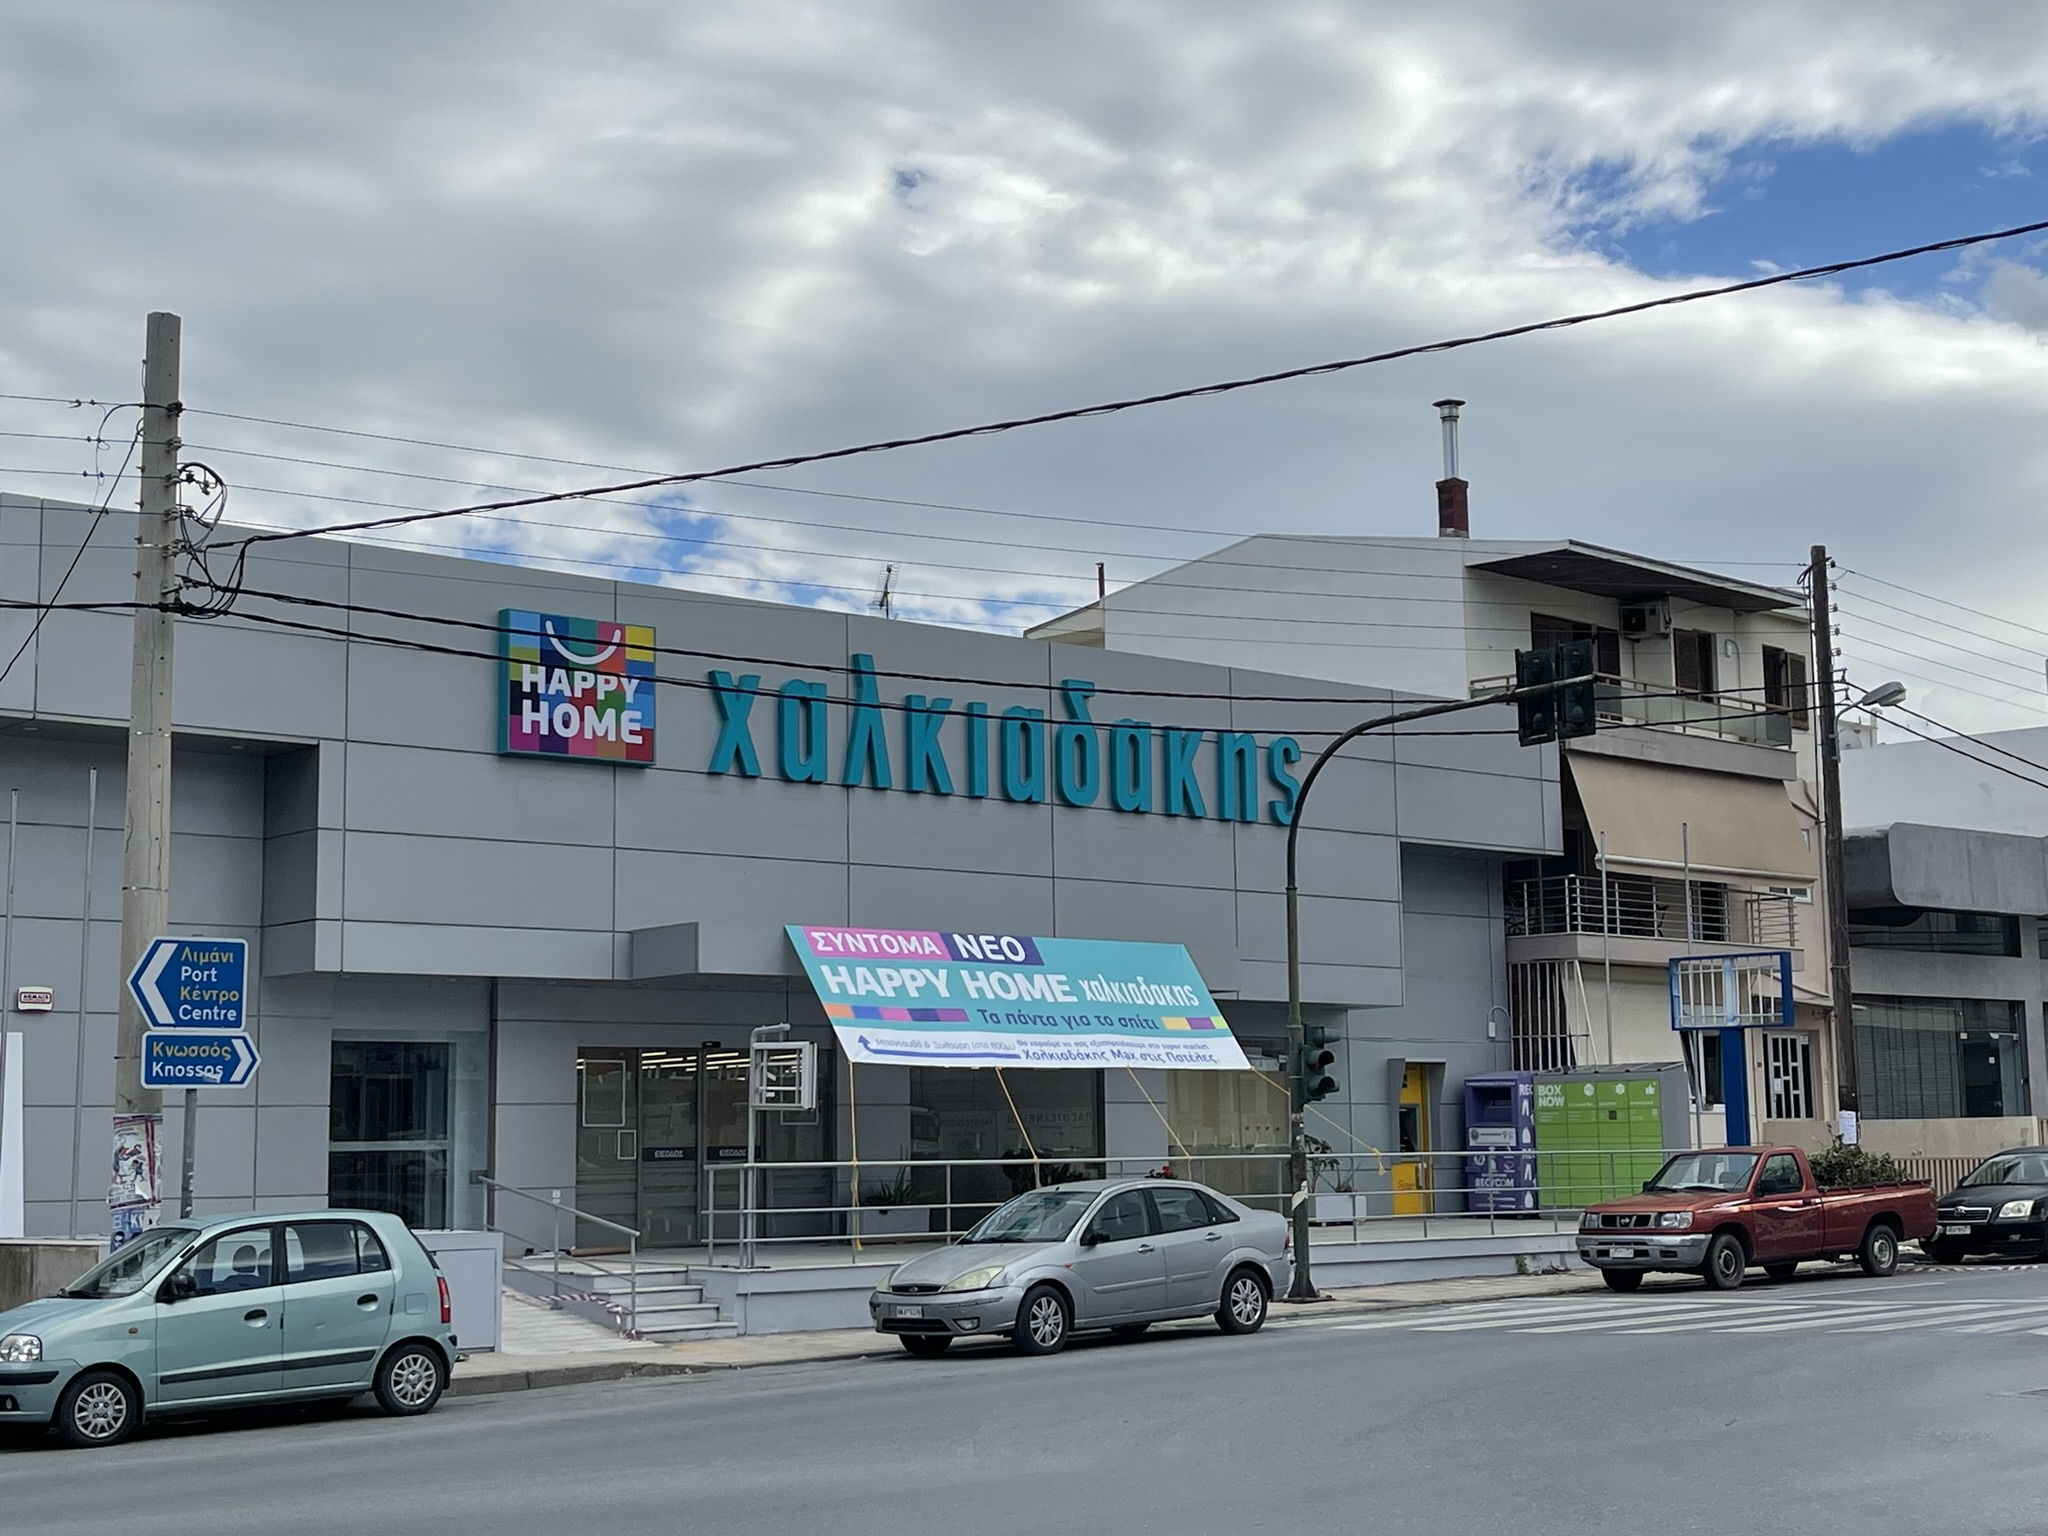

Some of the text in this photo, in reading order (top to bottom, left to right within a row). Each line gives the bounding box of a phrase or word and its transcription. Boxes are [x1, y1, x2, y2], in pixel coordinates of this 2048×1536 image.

[521, 664, 641, 704] HAPPY
[521, 699, 643, 744] HOME
[180, 946, 234, 965] Λιμάνι
[810, 931, 1026, 962] ΣΥΝΤΟΜΑ ΝΕΟ
[181, 966, 218, 982] Port
[820, 964, 950, 998] HAPPY
[960, 969, 1079, 1003] HOME
[180, 985, 239, 1004] Κέντρο
[179, 1005, 237, 1021] Centre
[976, 1008, 1159, 1030] Τα πάντα για το σπίτι
[152, 1041, 231, 1060] Κνωσσός
[1024, 1048, 1110, 1063] Χαλκιαδάκης
[1111, 1049, 1136, 1060] Max
[1140, 1051, 1166, 1064] στις
[152, 1061, 223, 1078] Knossos
[1538, 1084, 1562, 1096] BOX
[1538, 1096, 1565, 1108] NOW
